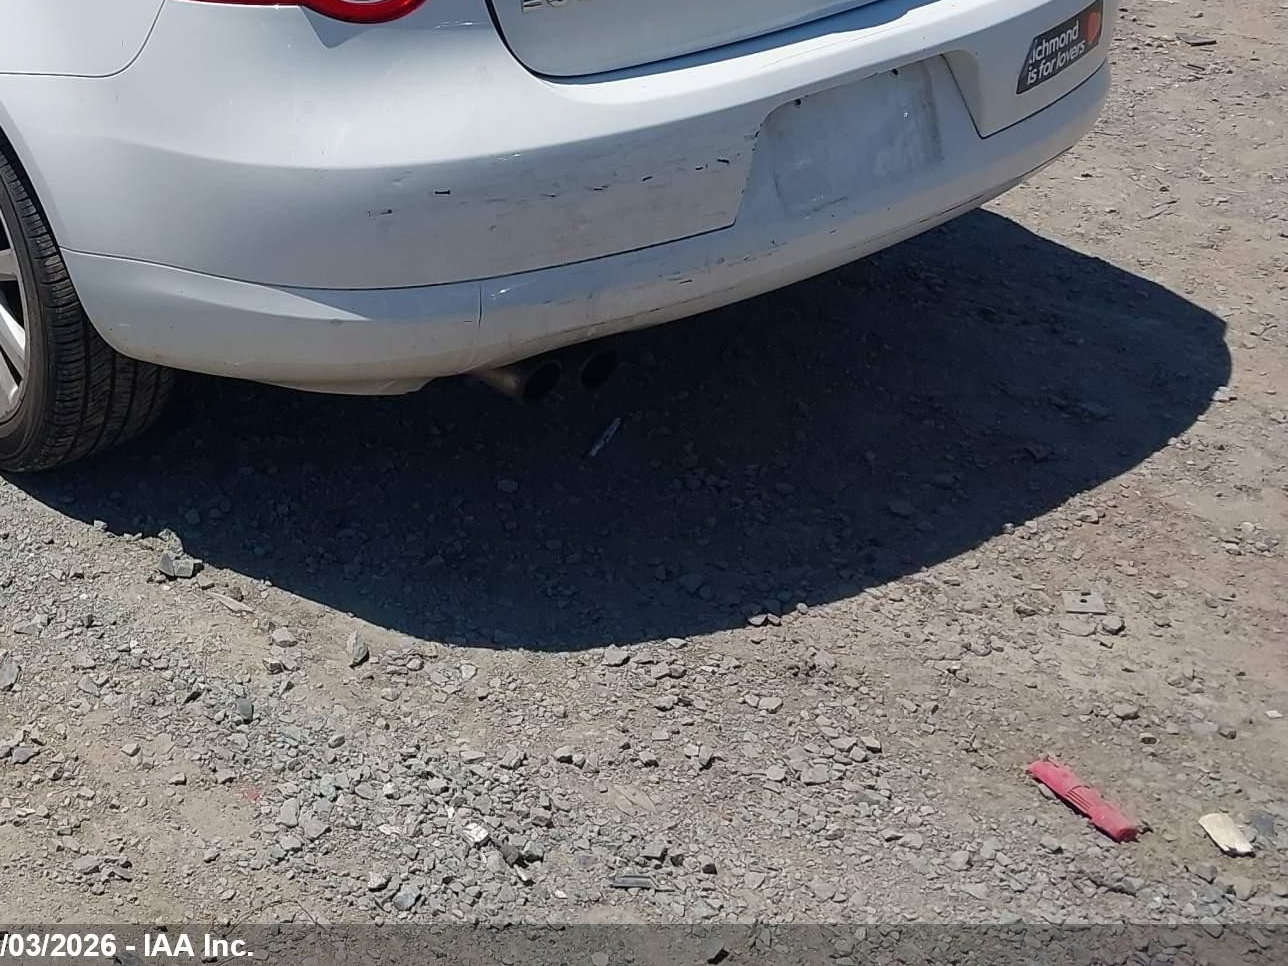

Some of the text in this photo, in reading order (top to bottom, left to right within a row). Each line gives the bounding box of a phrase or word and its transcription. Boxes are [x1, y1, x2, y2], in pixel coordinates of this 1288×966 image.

[1027, 40, 1086, 85] is for lovers
[1028, 20, 1080, 65] ichmond
